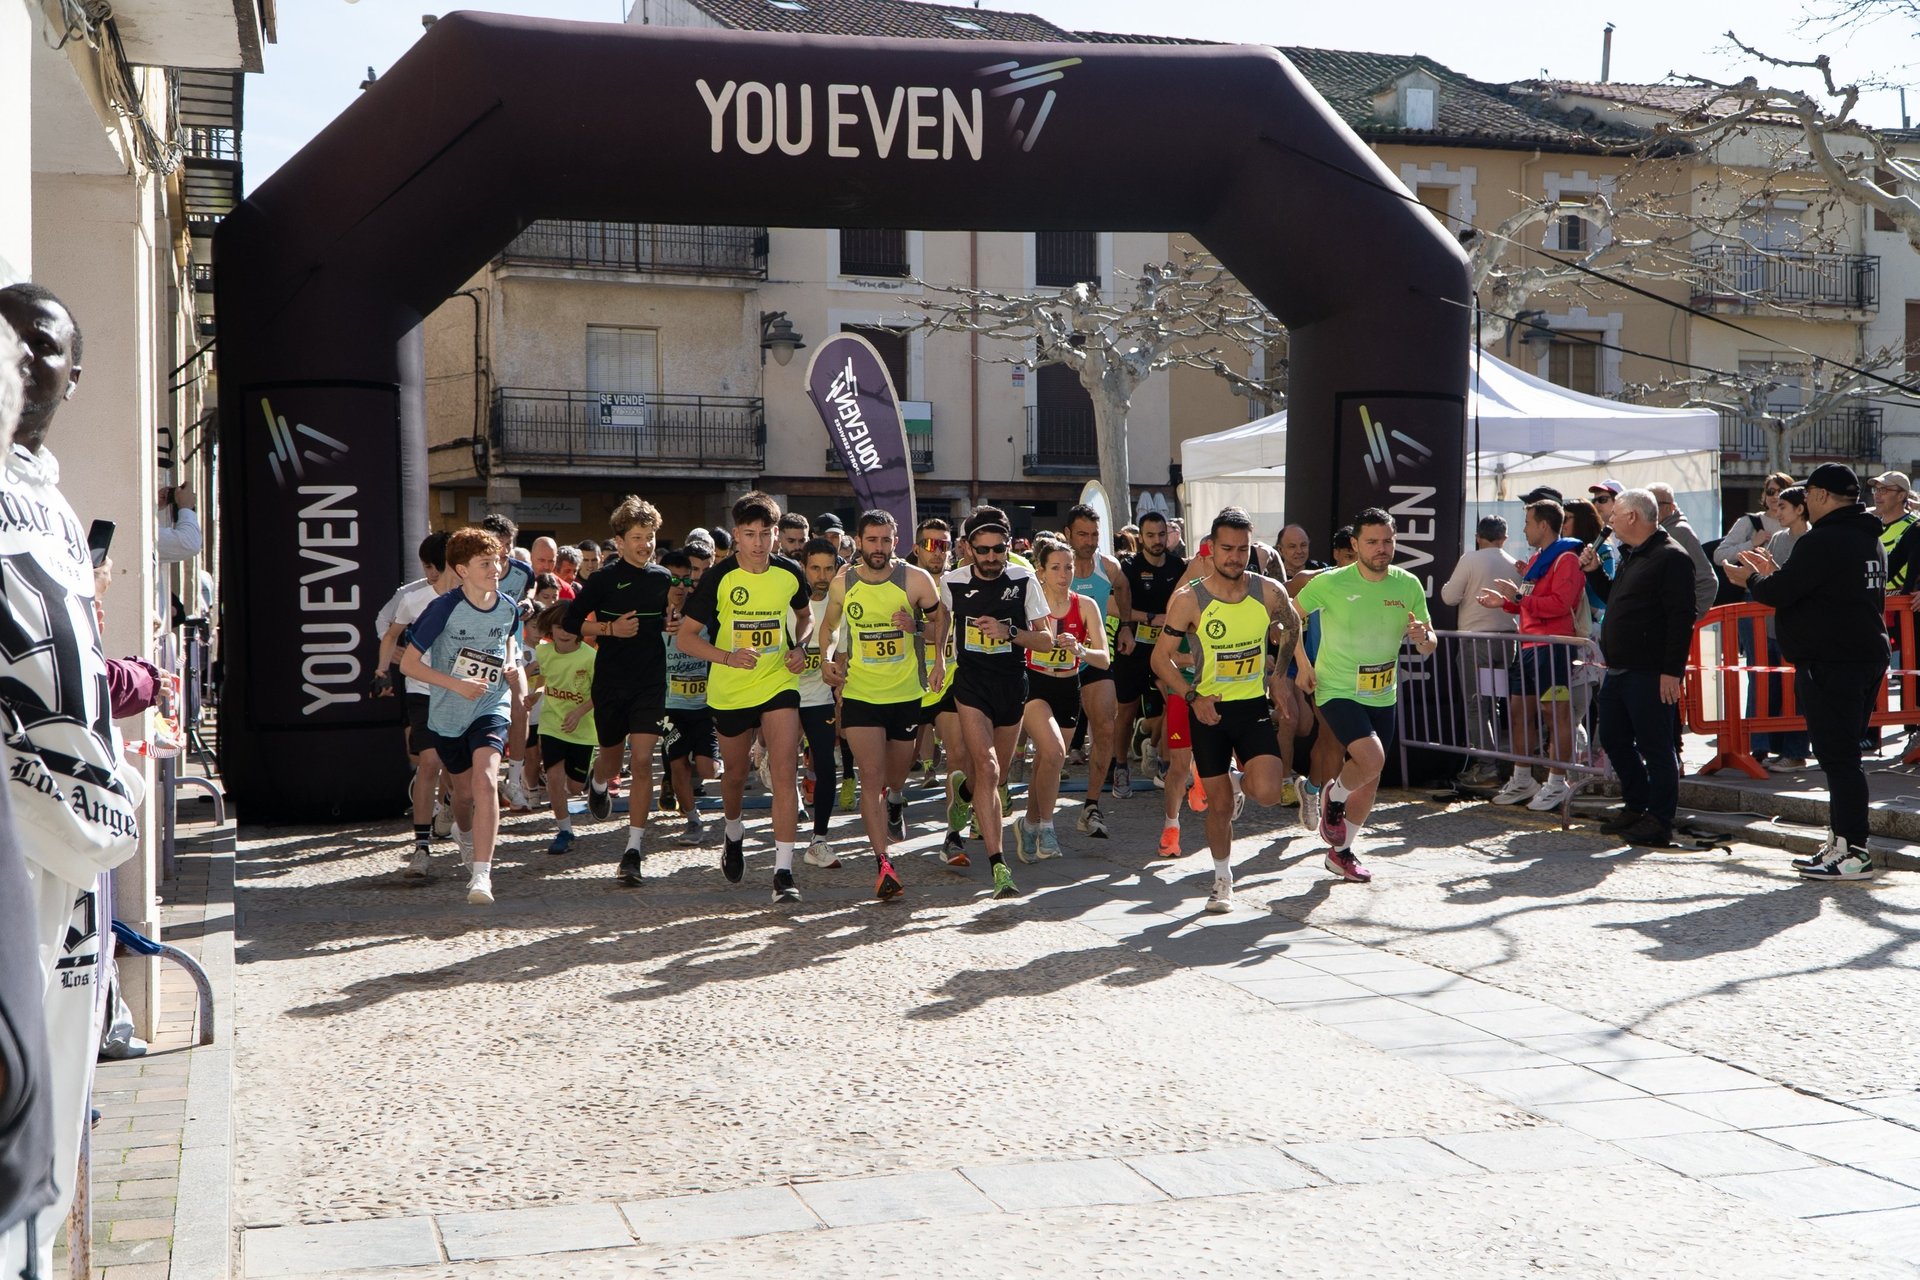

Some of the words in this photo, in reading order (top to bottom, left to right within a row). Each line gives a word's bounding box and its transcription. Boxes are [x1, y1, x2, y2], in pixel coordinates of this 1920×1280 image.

[695, 78, 813, 156] YOU
[828, 84, 982, 161] EVEN
[600, 394, 613, 405] SE
[613, 394, 644, 406] VENDE
[297, 485, 360, 611] EVEN
[751, 630, 773, 647] 90
[876, 640, 897, 657] 36
[1049, 649, 1067, 662] 78
[301, 622, 361, 715] YOU
[467, 663, 498, 683] 316
[1235, 658, 1255, 676] 77
[680, 681, 706, 695] 108
[1370, 669, 1393, 689] 114
[60, 970, 90, 989] Los
